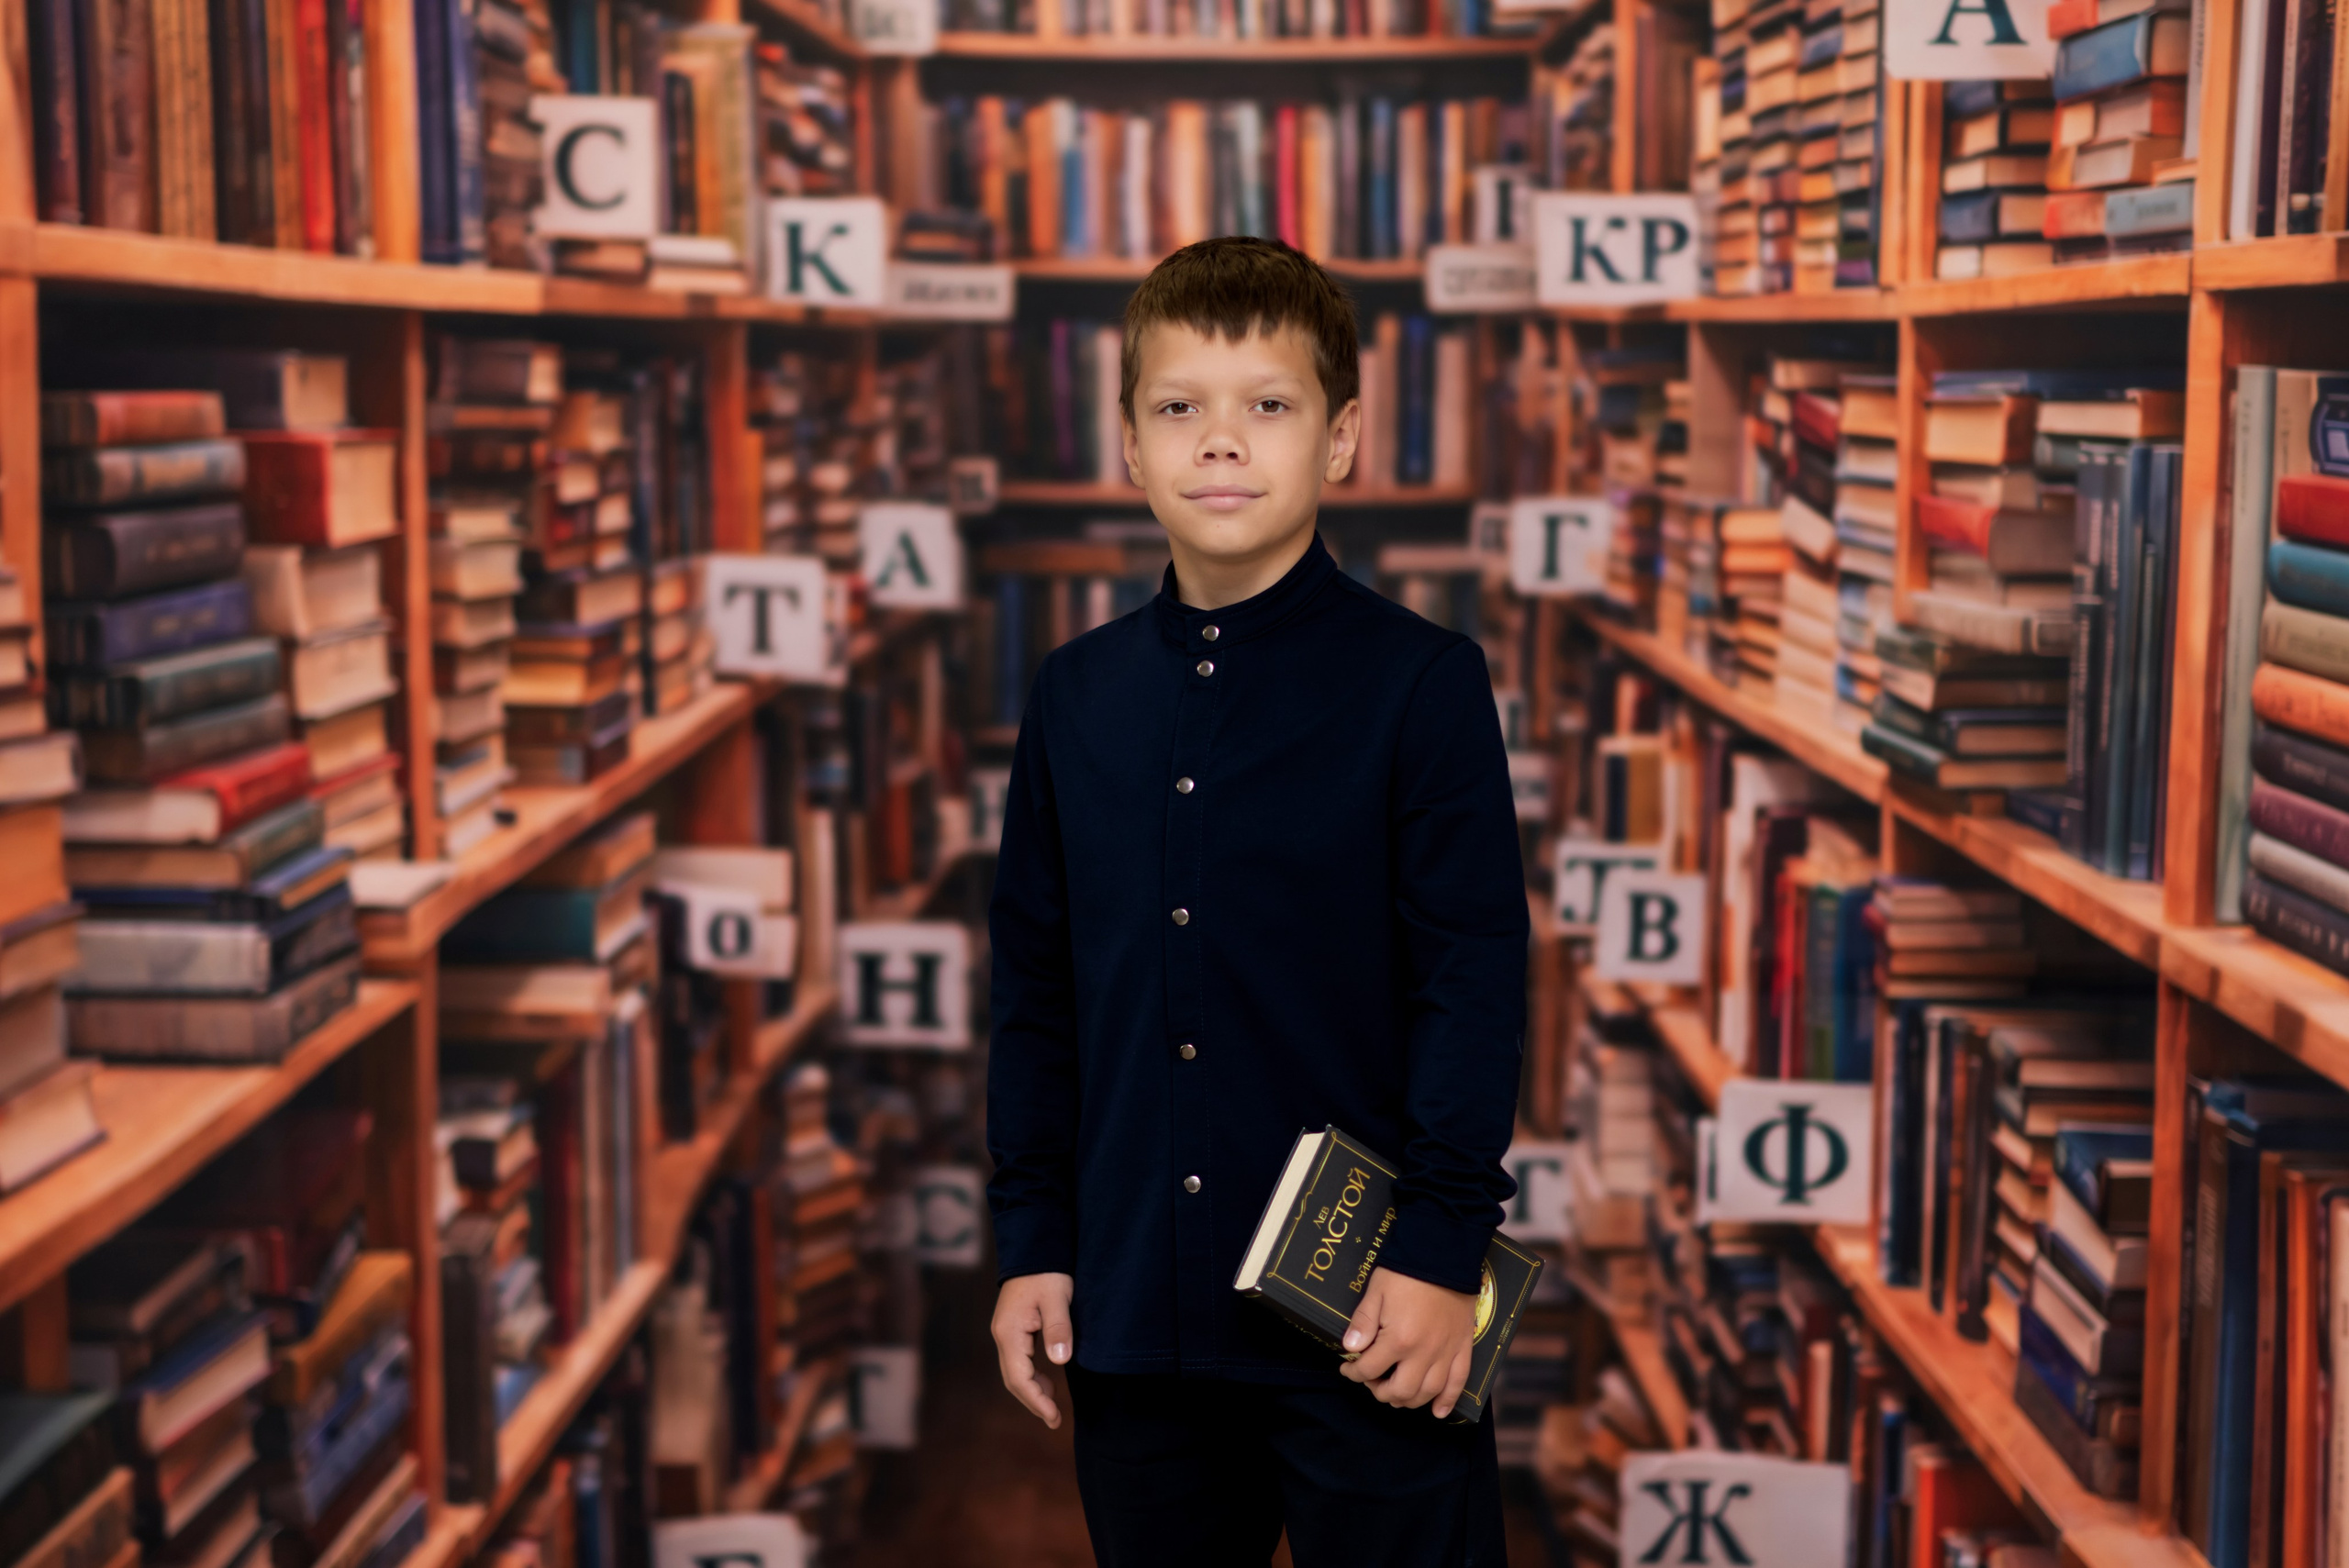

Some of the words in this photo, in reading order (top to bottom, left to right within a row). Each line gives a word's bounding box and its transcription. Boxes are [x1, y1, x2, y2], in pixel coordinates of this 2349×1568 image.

[554, 122, 627, 211] С
[785, 220, 853, 295] К
[1570, 215, 1690, 284] КР
[875, 529, 934, 588] А
[1541, 513, 1590, 581] Г
[723, 582, 801, 656] Т
[1626, 890, 1679, 962] В
[854, 951, 945, 1029] Н
[1744, 1104, 1848, 1205] Ф
[1304, 1166, 1371, 1283] ТОЛСТОЙ
[1313, 1206, 1330, 1229] ЛЕВ
[1372, 1236, 1383, 1249] и
[1377, 1206, 1398, 1236] мир
[1349, 1248, 1377, 1294] Война
[1640, 1481, 1754, 1566] Ж
